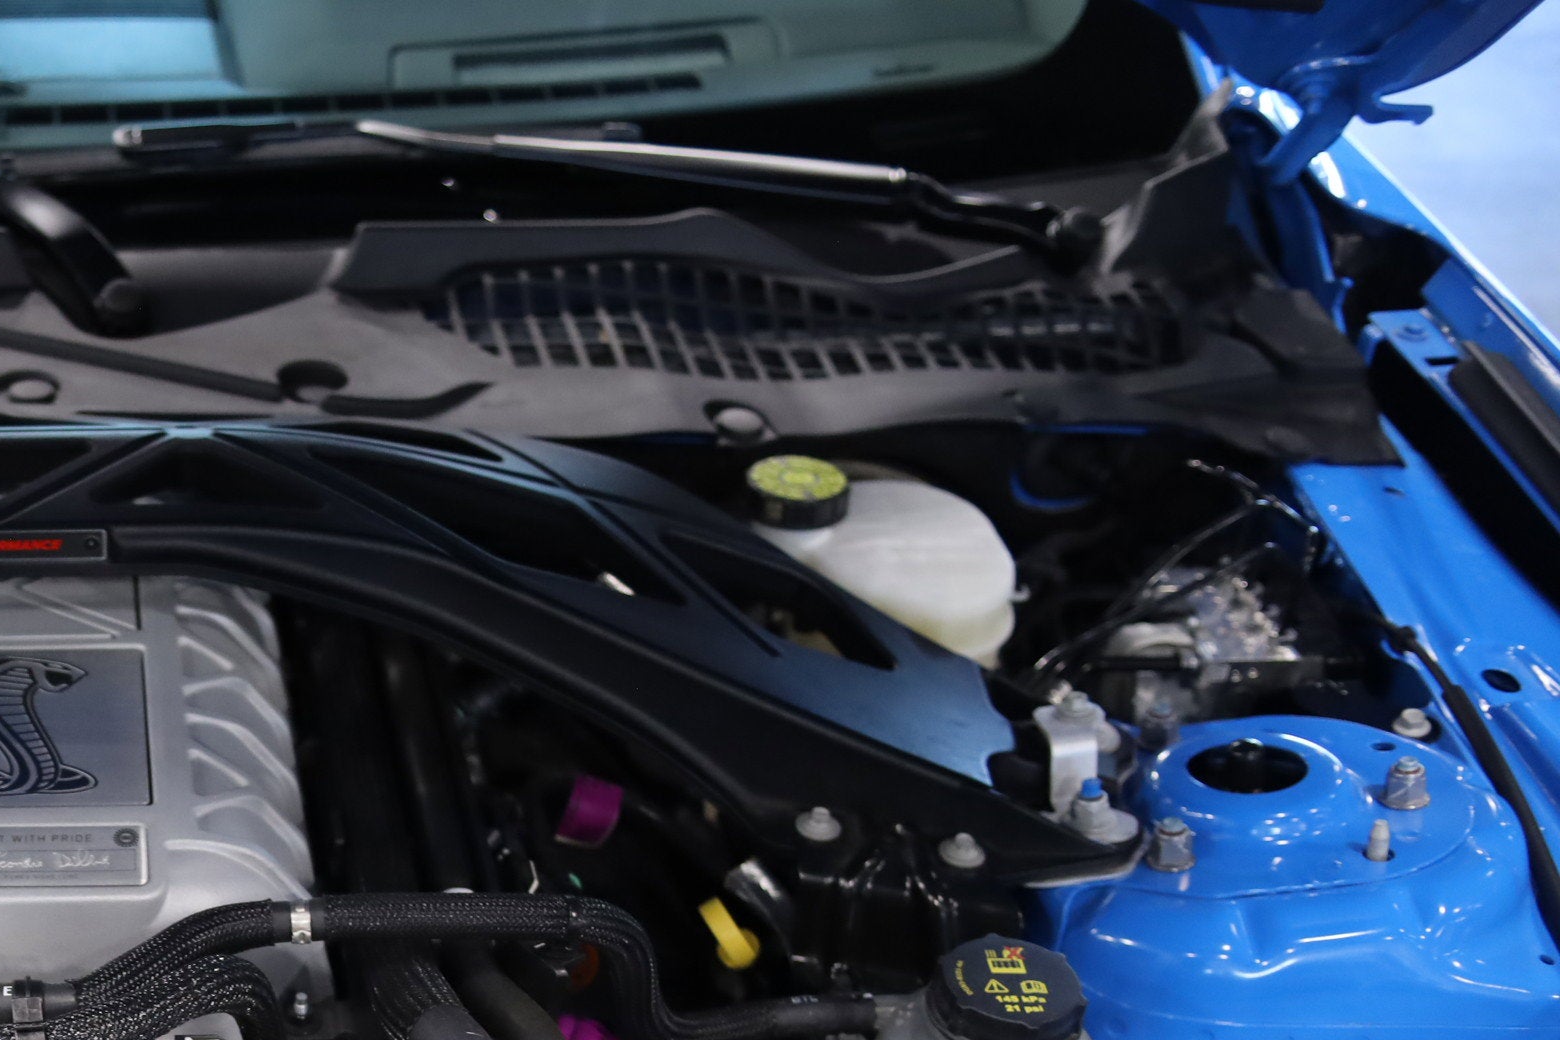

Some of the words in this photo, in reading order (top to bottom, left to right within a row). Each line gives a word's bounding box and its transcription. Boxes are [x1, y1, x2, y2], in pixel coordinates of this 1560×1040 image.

[11, 834, 46, 843] WITH
[51, 833, 93, 844] PRIDE
[995, 994, 1019, 1003] 145
[1005, 1004, 1021, 1012] 21
